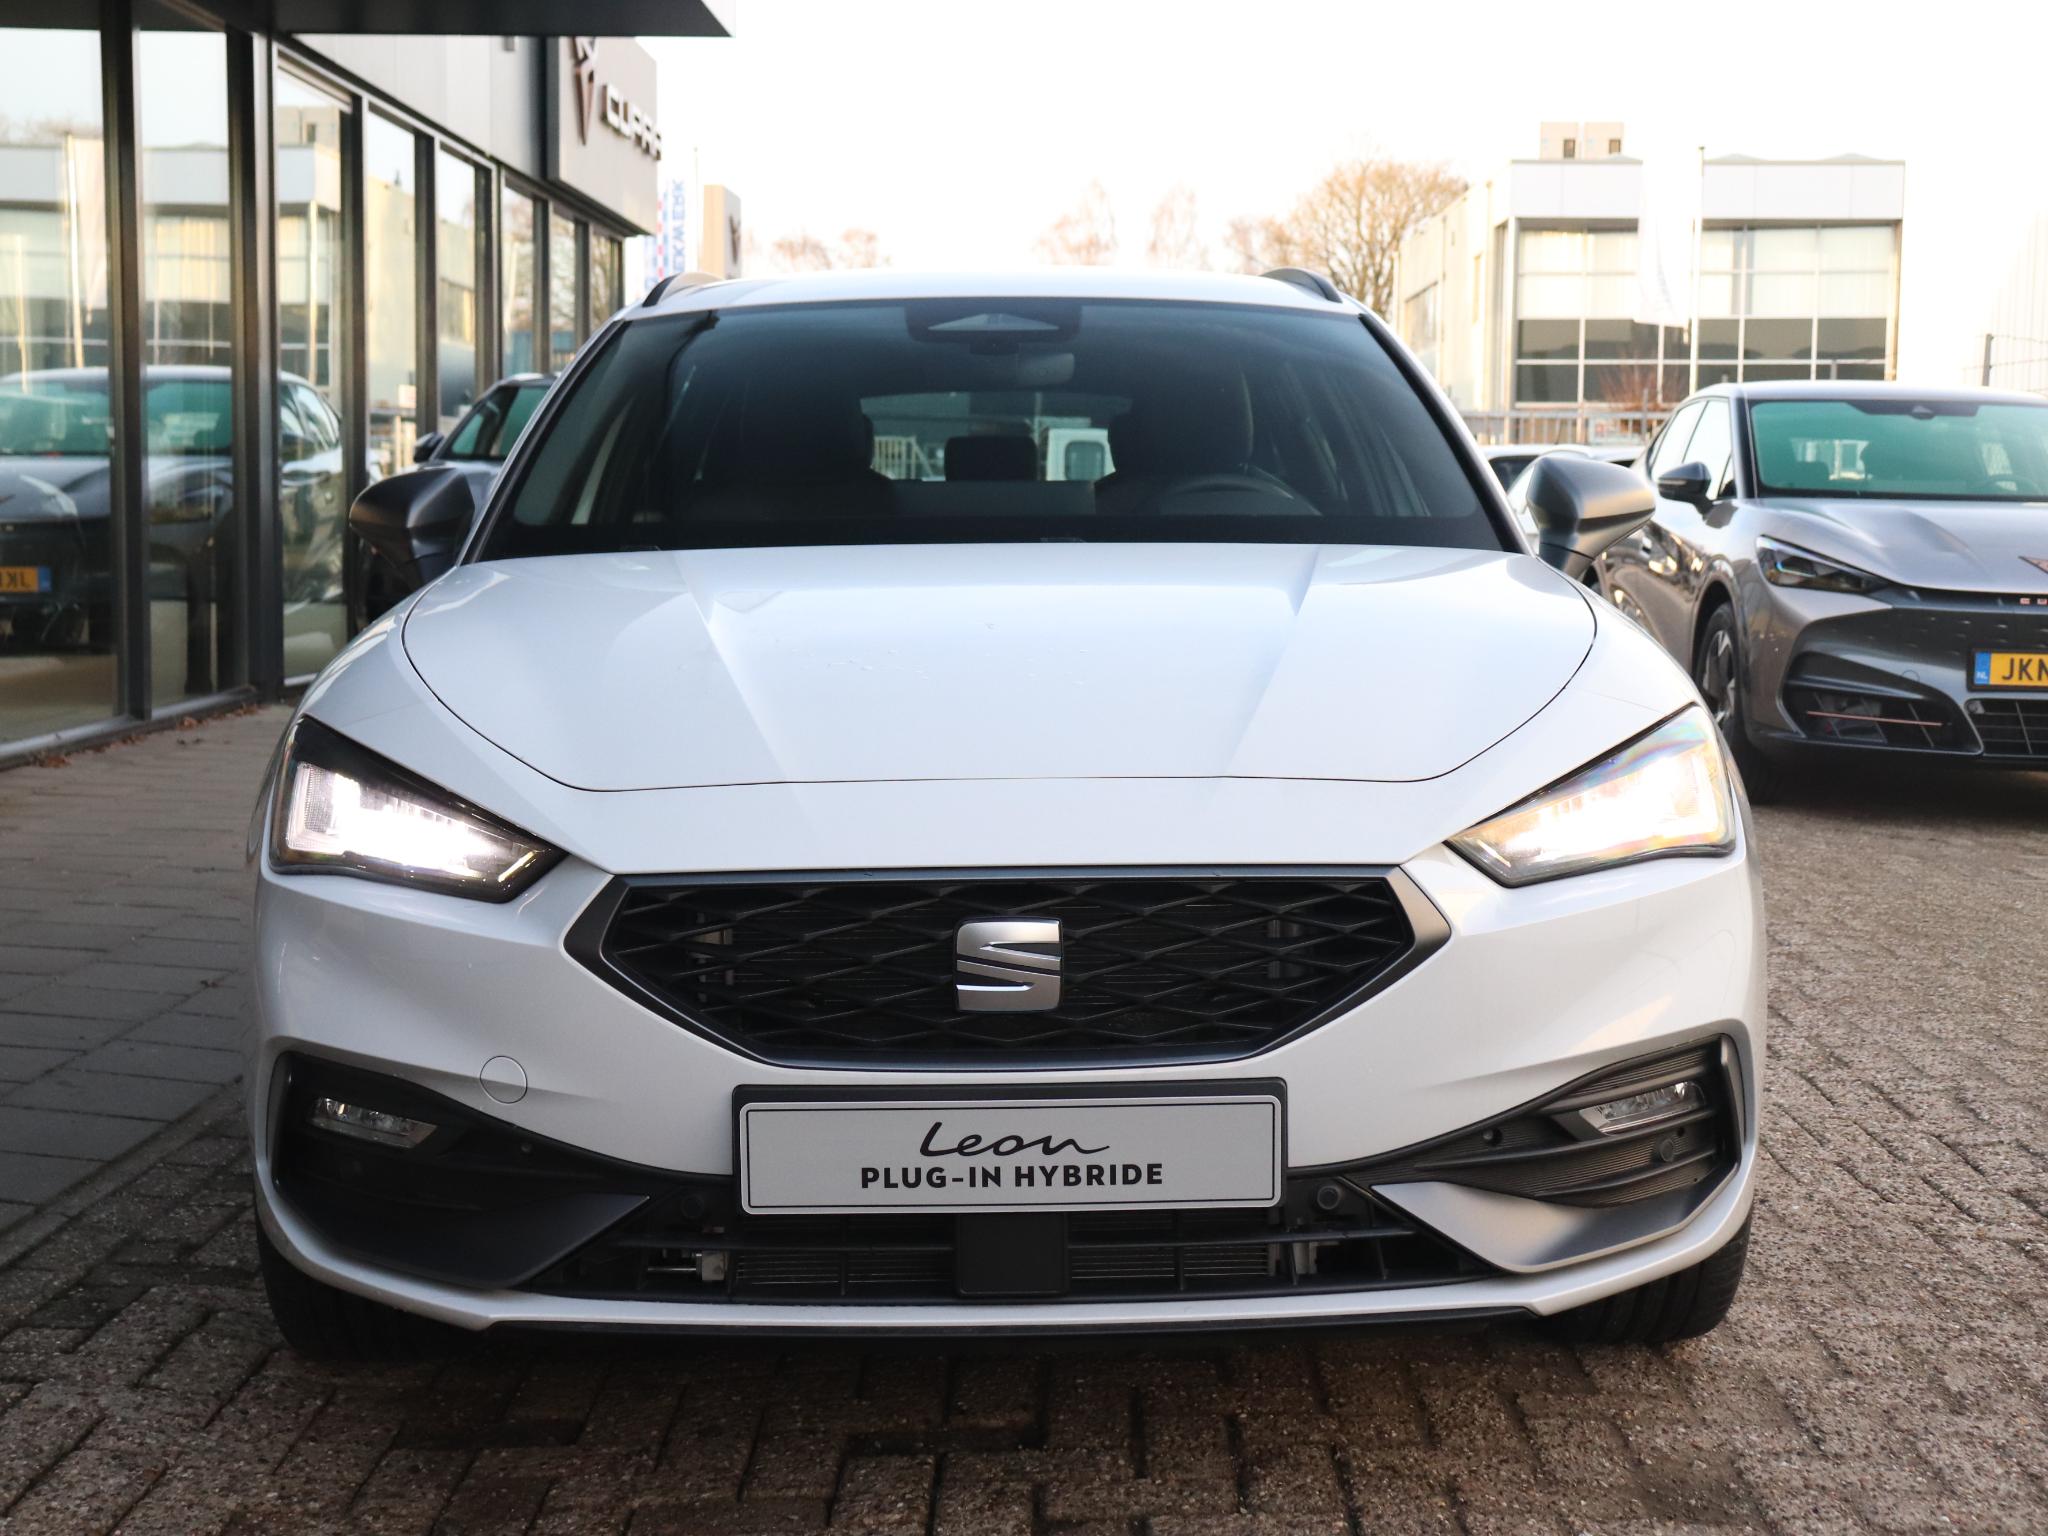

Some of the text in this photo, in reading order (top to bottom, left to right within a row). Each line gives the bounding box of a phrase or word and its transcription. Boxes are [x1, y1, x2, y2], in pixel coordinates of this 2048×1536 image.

[920, 1121, 1109, 1157] Leon
[861, 1163, 1163, 1189] PLUG-IN HYBRIDE
